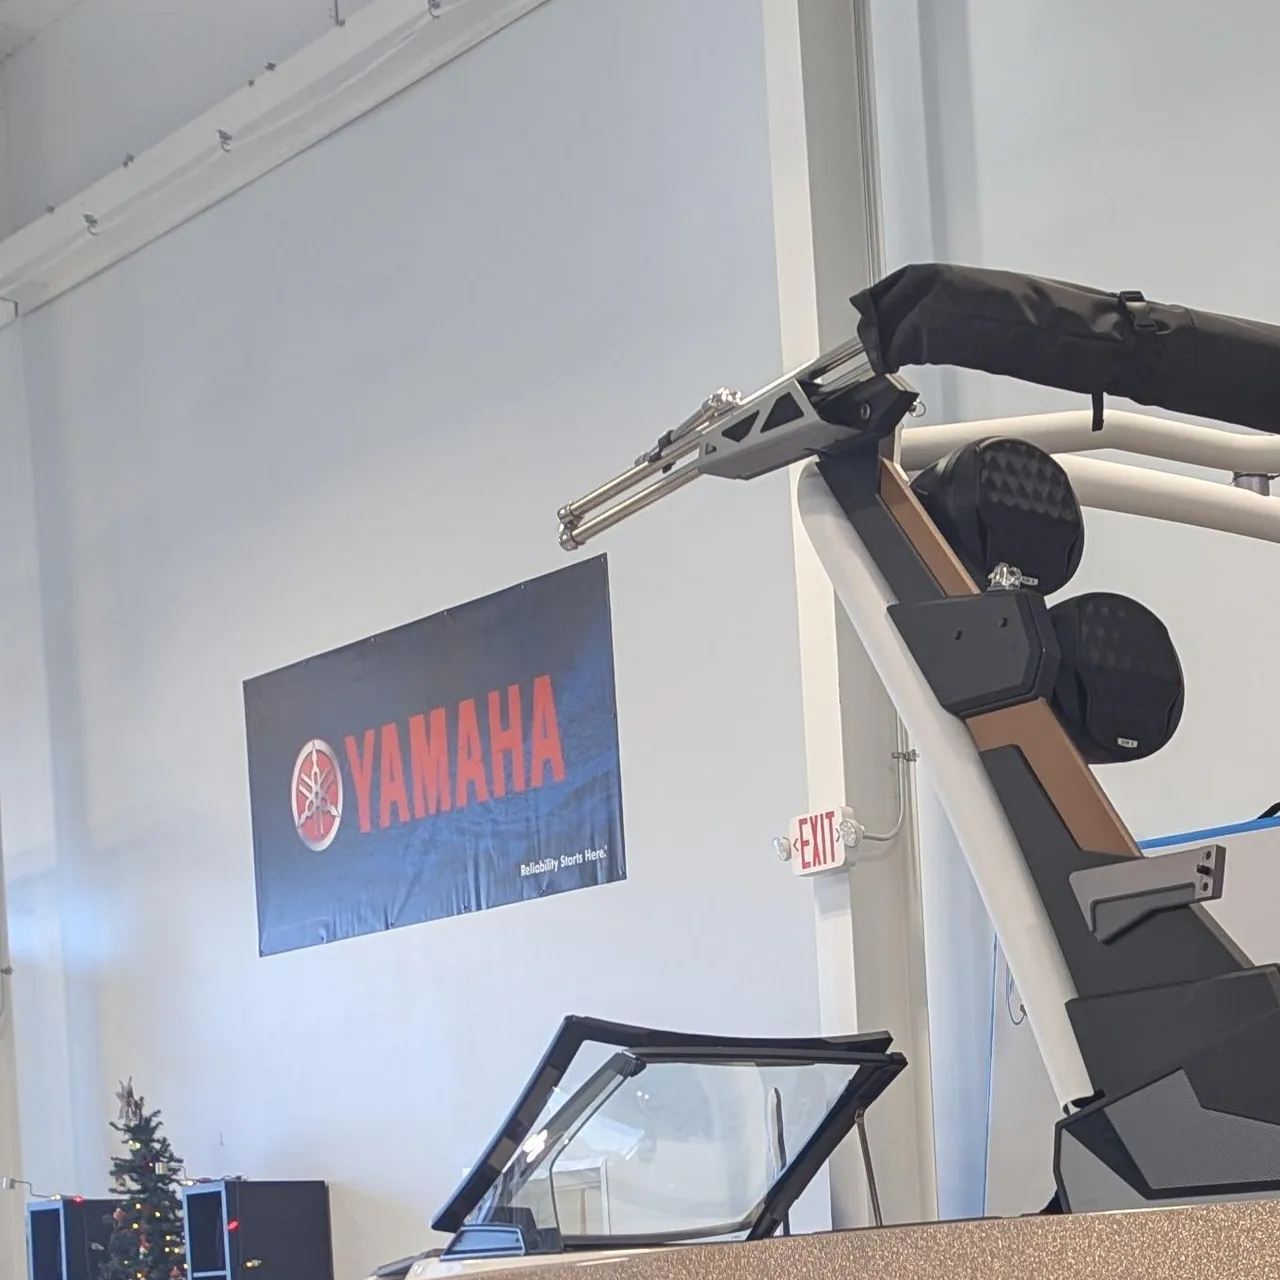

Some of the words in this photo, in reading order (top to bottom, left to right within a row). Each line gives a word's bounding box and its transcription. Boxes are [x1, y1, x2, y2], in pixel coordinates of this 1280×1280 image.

[344, 674, 566, 834] YAMAHA
[520, 858, 559, 877] Reliability
[560, 852, 583, 868] Starts
[798, 811, 835, 869] EXIT
